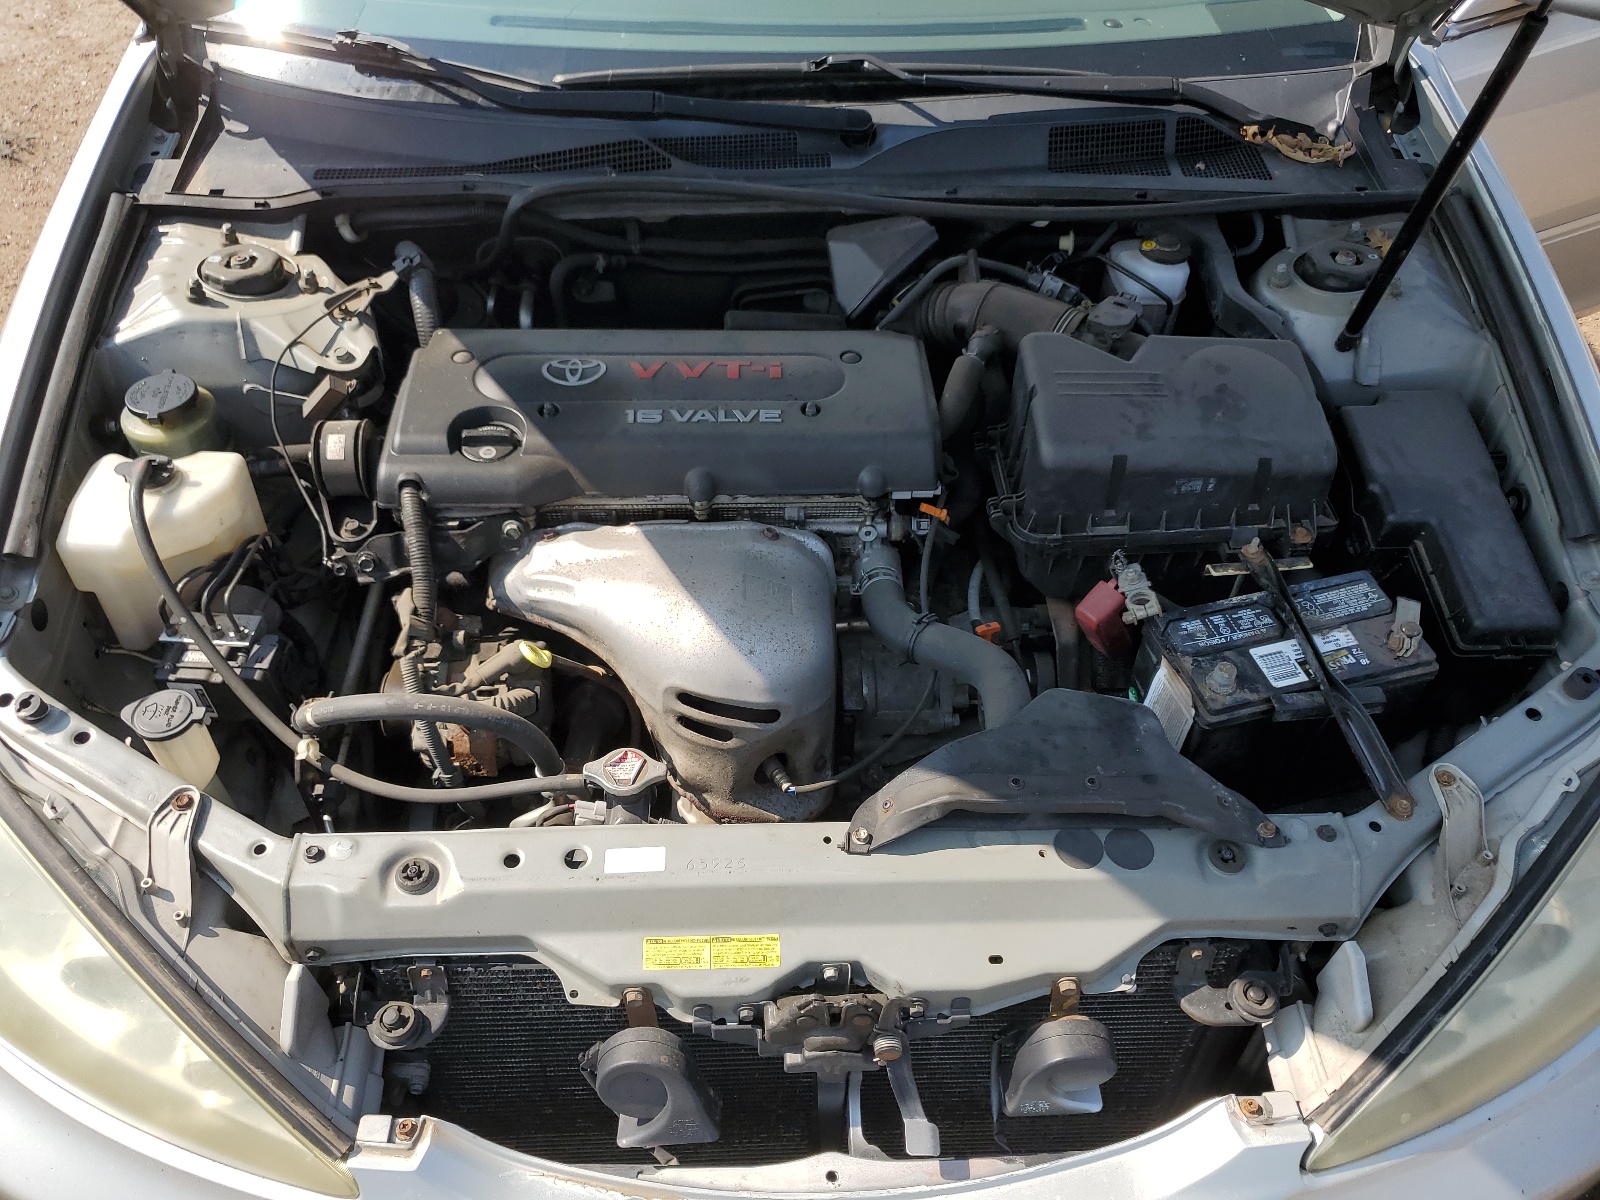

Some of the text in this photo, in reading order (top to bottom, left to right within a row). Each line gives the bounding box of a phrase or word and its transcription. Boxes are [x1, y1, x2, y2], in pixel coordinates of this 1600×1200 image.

[629, 361, 783, 379] VVT-i
[625, 409, 783, 424] 16 VALVE
[1232, 629, 1260, 641] DANGER
[1198, 637, 1226, 647] POISON
